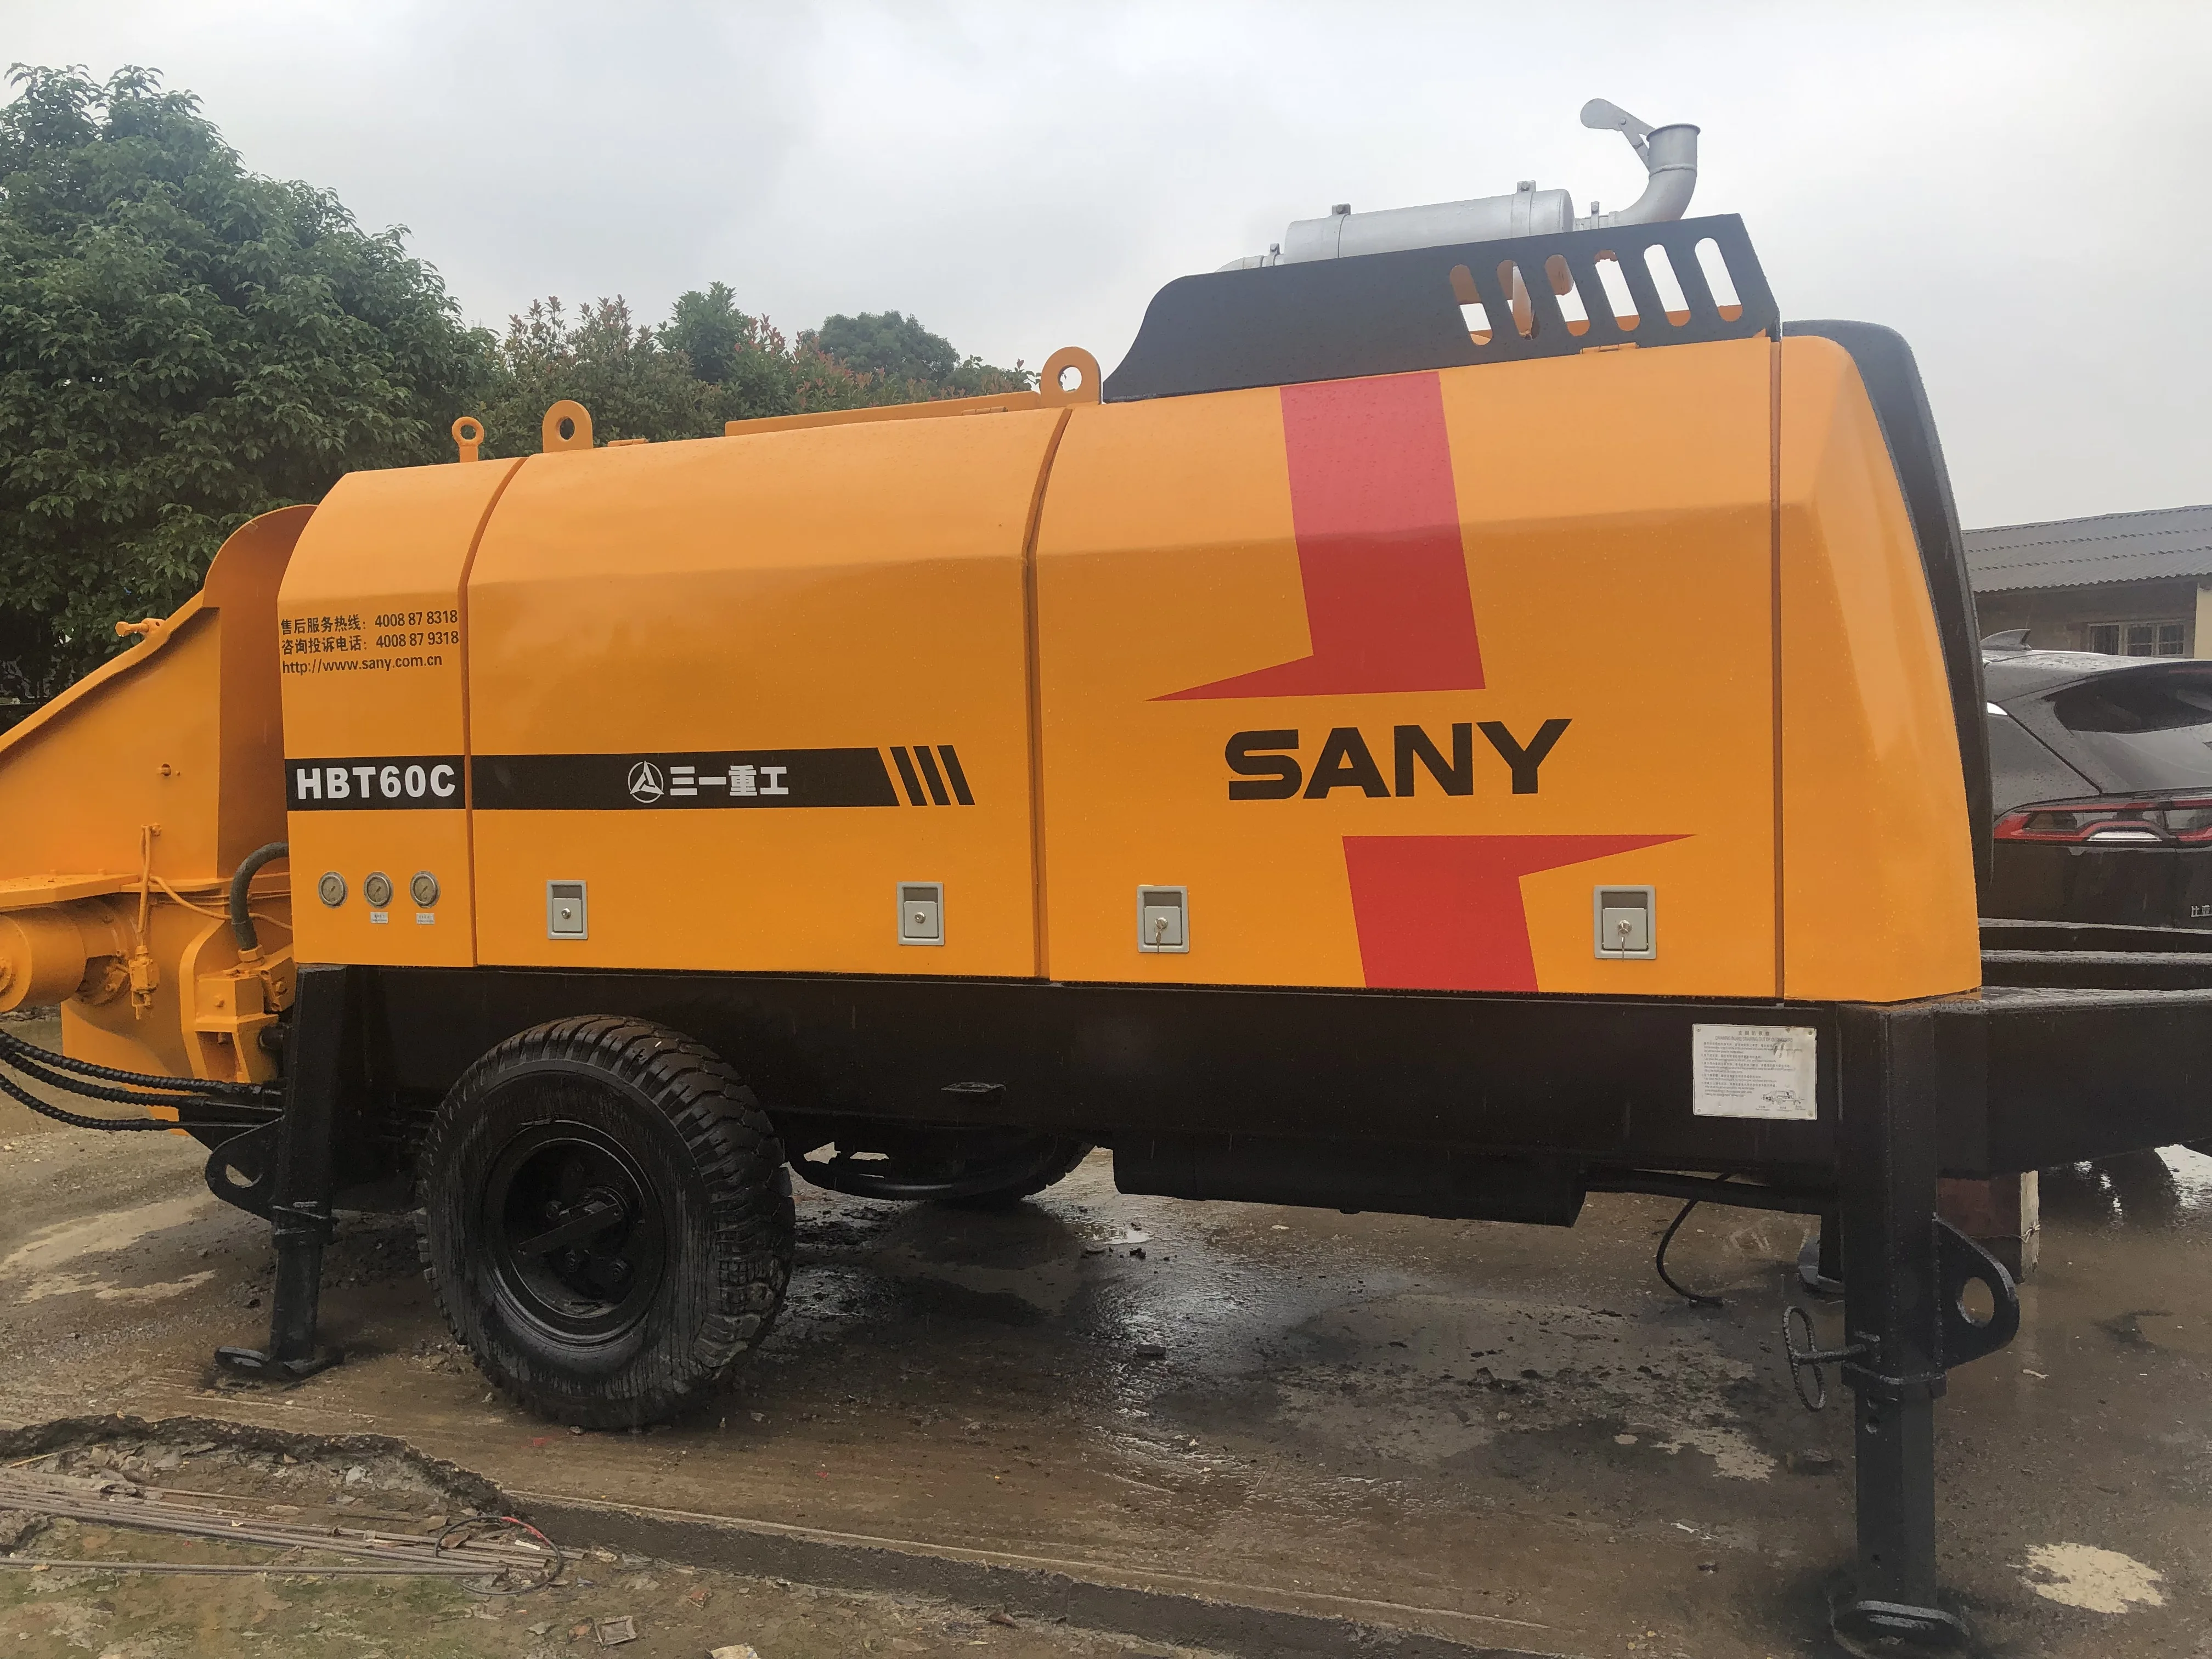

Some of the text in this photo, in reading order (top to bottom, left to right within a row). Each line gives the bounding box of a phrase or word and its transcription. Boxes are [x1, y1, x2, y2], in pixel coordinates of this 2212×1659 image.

[375, 613, 405, 628] 4008
[408, 612, 422, 625] 87
[426, 610, 458, 624] 8318
[376, 634, 407, 648] 4008
[409, 633, 424, 646] 87
[427, 631, 459, 645] 9318
[282, 655, 443, 676] http://www.sany.com.cn
[1224, 718, 1573, 800] SANY
[297, 764, 455, 799] HBT60C
[670, 765, 789, 796] 三一重工
